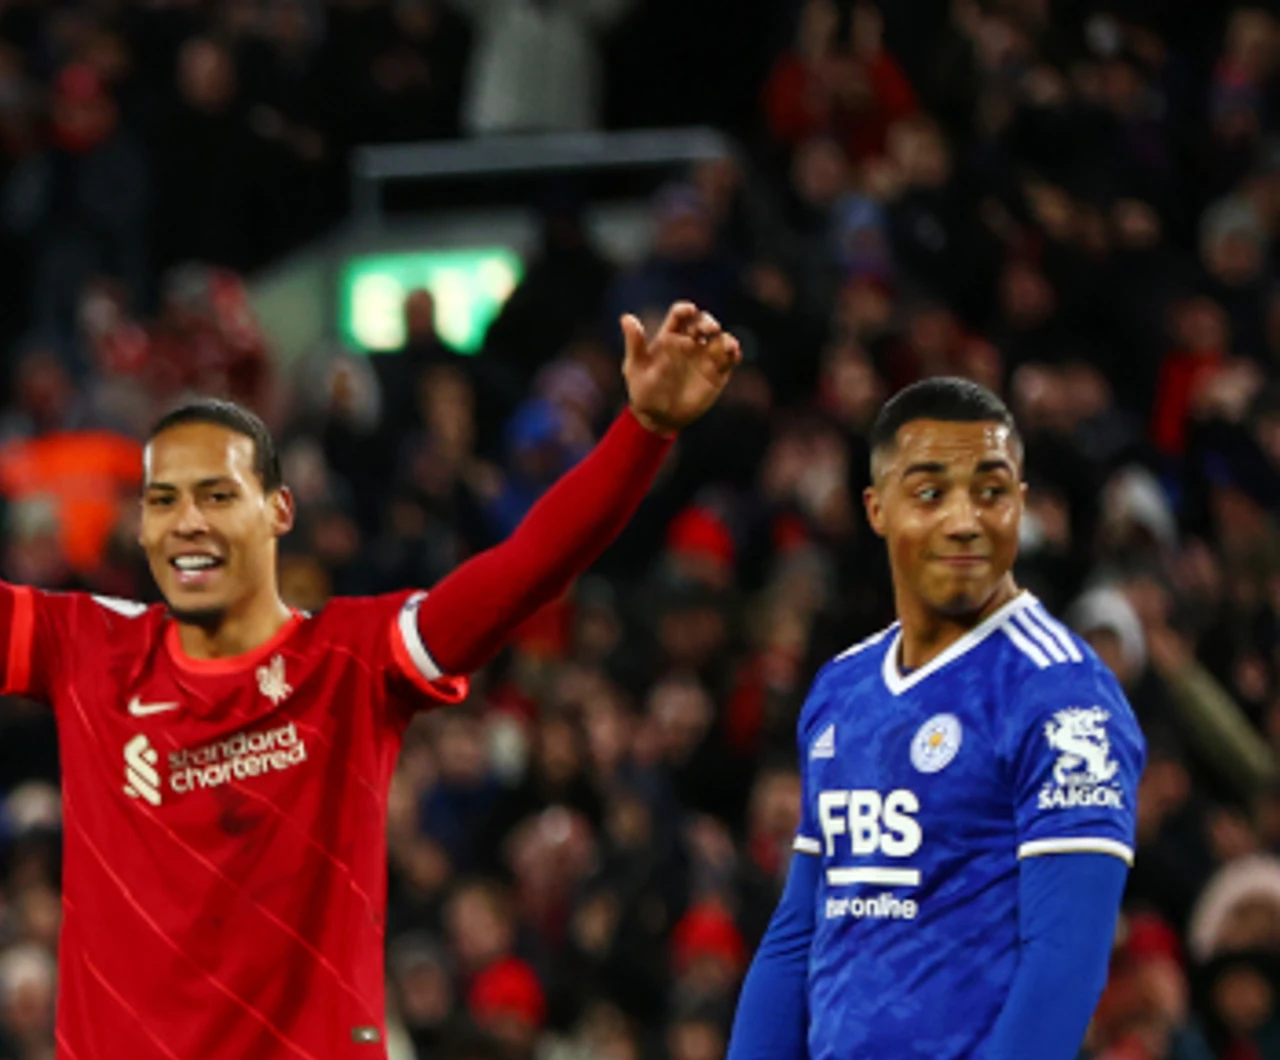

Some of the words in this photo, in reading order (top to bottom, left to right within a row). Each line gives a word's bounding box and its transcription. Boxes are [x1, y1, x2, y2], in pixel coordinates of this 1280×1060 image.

[168, 722, 298, 768] standard
[169, 741, 307, 793] chartered
[1037, 785, 1124, 810] SAIGON
[818, 789, 922, 858] FBS
